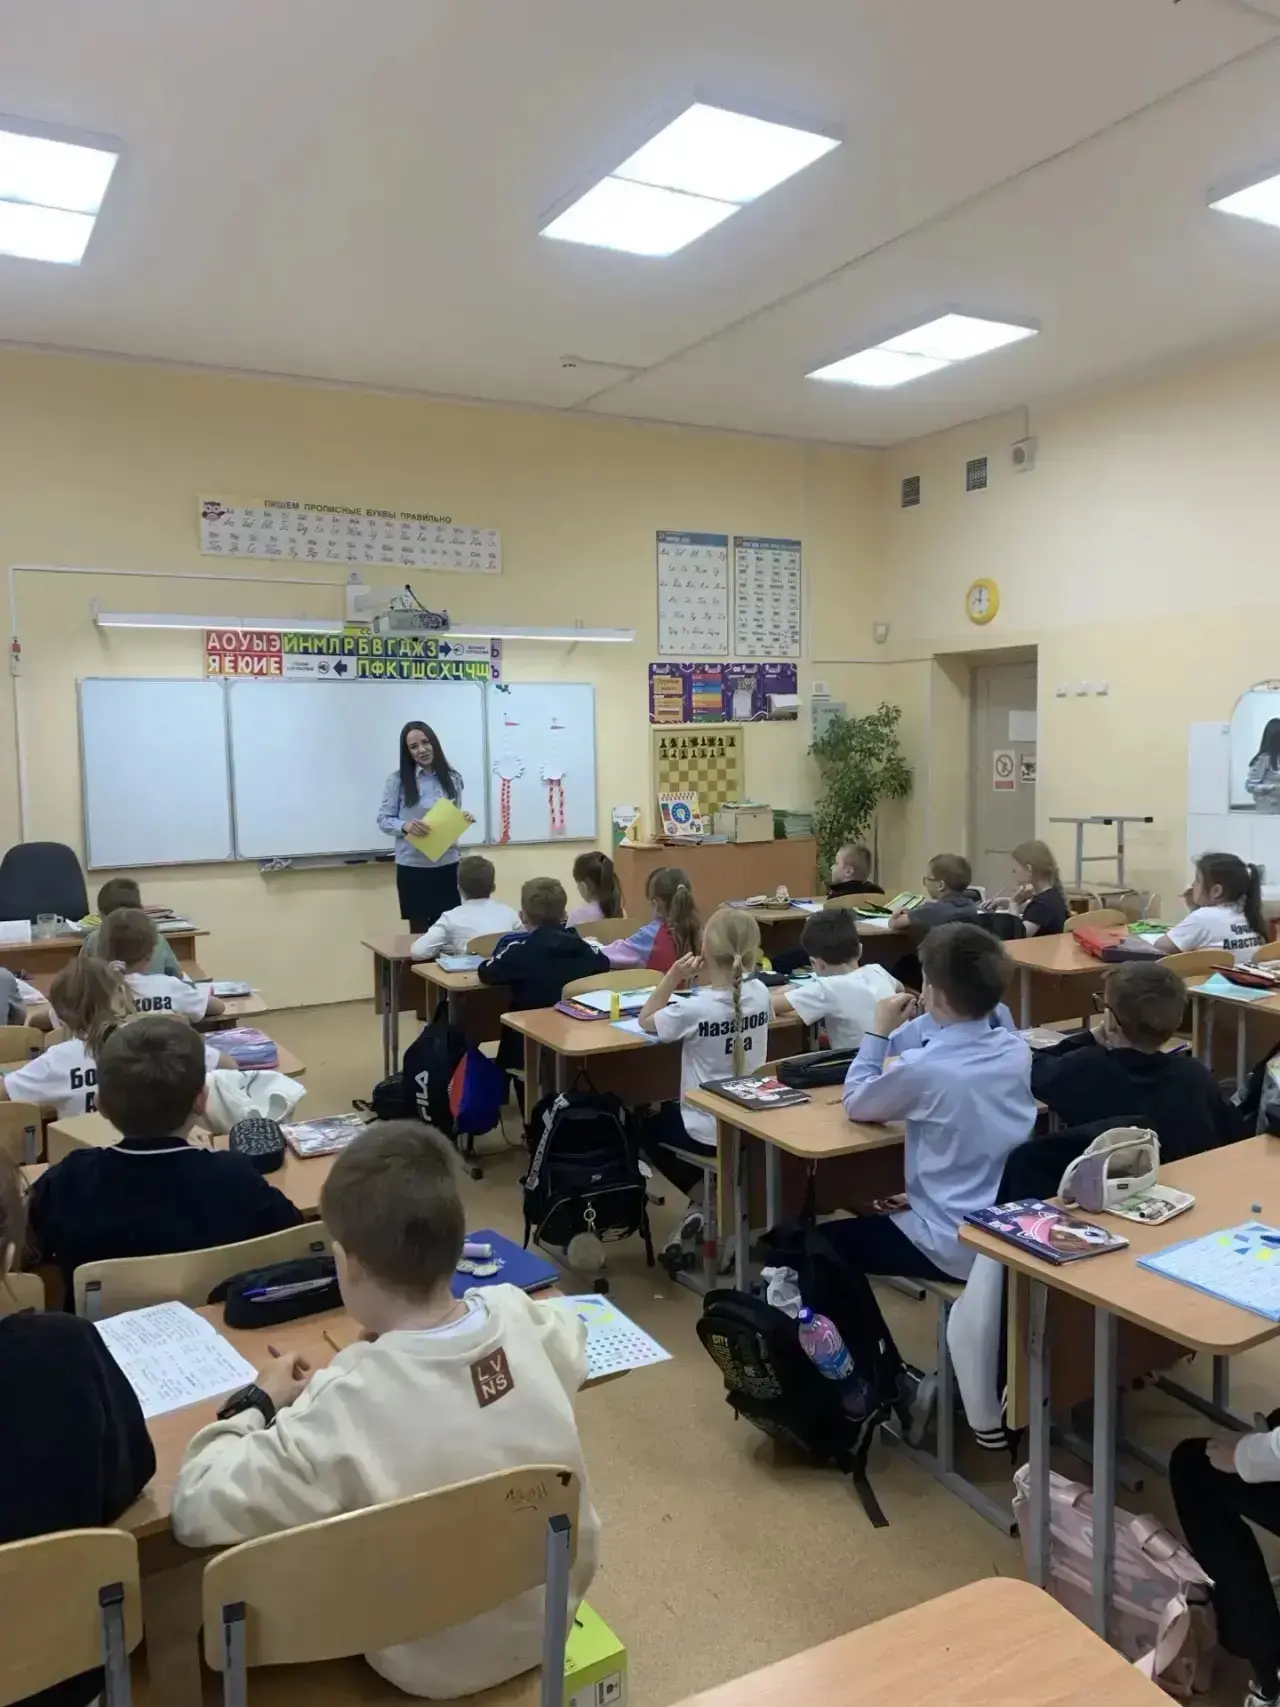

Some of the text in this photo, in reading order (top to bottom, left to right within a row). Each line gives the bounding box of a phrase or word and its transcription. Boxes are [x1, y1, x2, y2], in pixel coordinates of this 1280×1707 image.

[264, 500, 452, 524] ПИШЕМ ПРОПИСНЫЕ БУКВЫ ПРАВИЛЬНО
[725, 1036, 752, 1055] Еа
